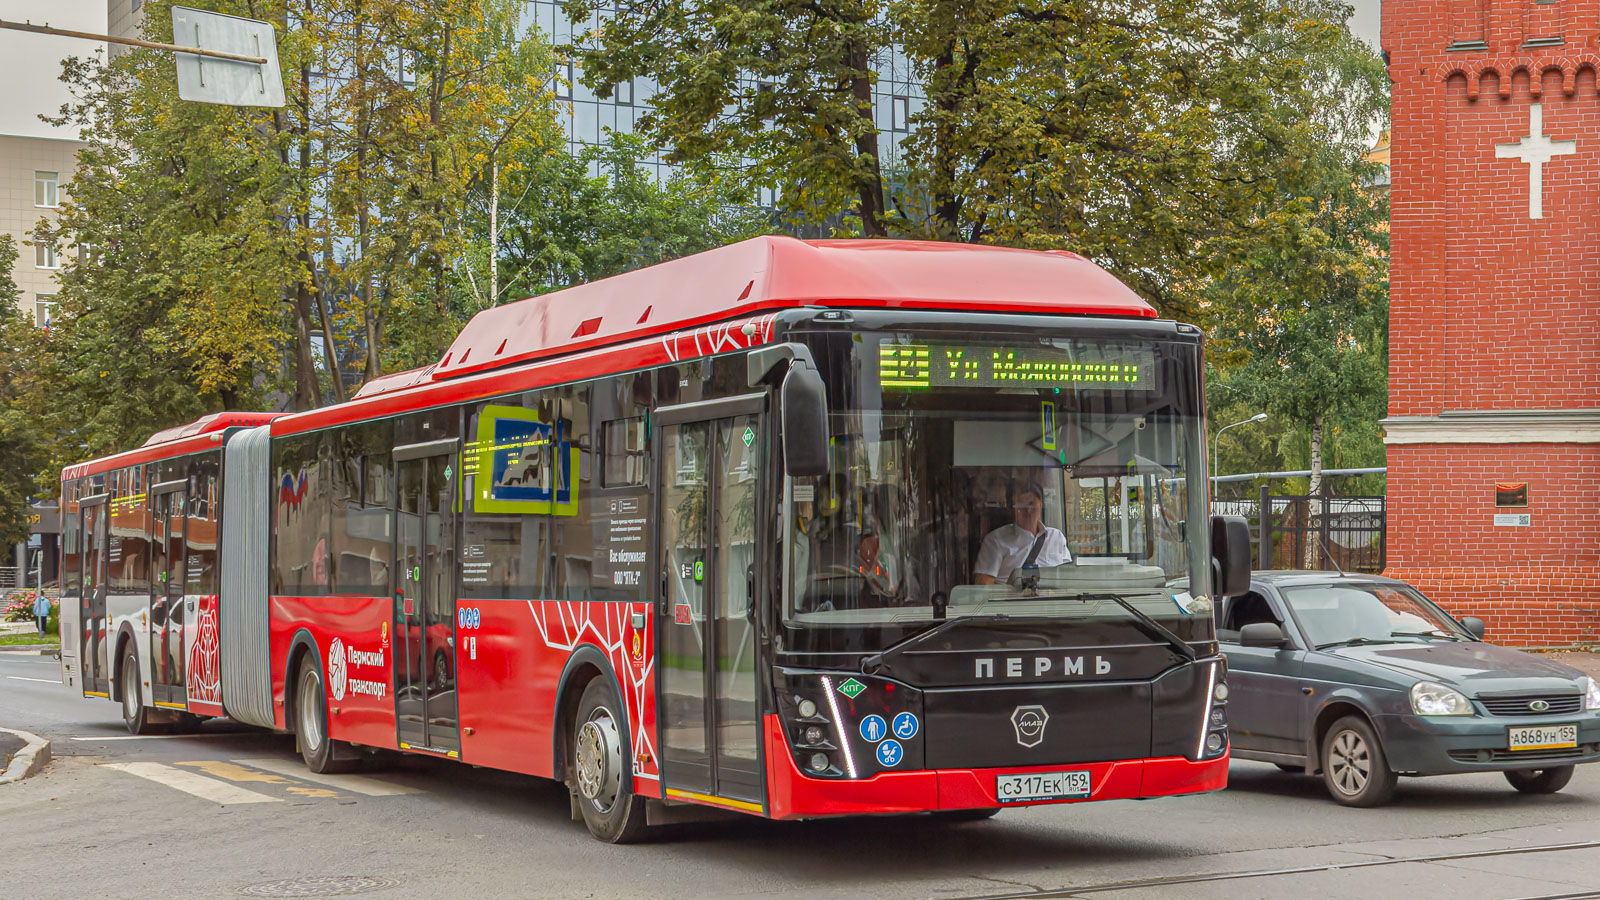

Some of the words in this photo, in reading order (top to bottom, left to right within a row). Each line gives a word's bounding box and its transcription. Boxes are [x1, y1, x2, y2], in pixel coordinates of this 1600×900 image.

[348, 646, 384, 669] Пермский
[975, 655, 1111, 678] ПЕРМЬ
[348, 678, 386, 701] транспорт
[843, 684, 860, 693] КПГ
[1064, 773, 1086, 787] 159
